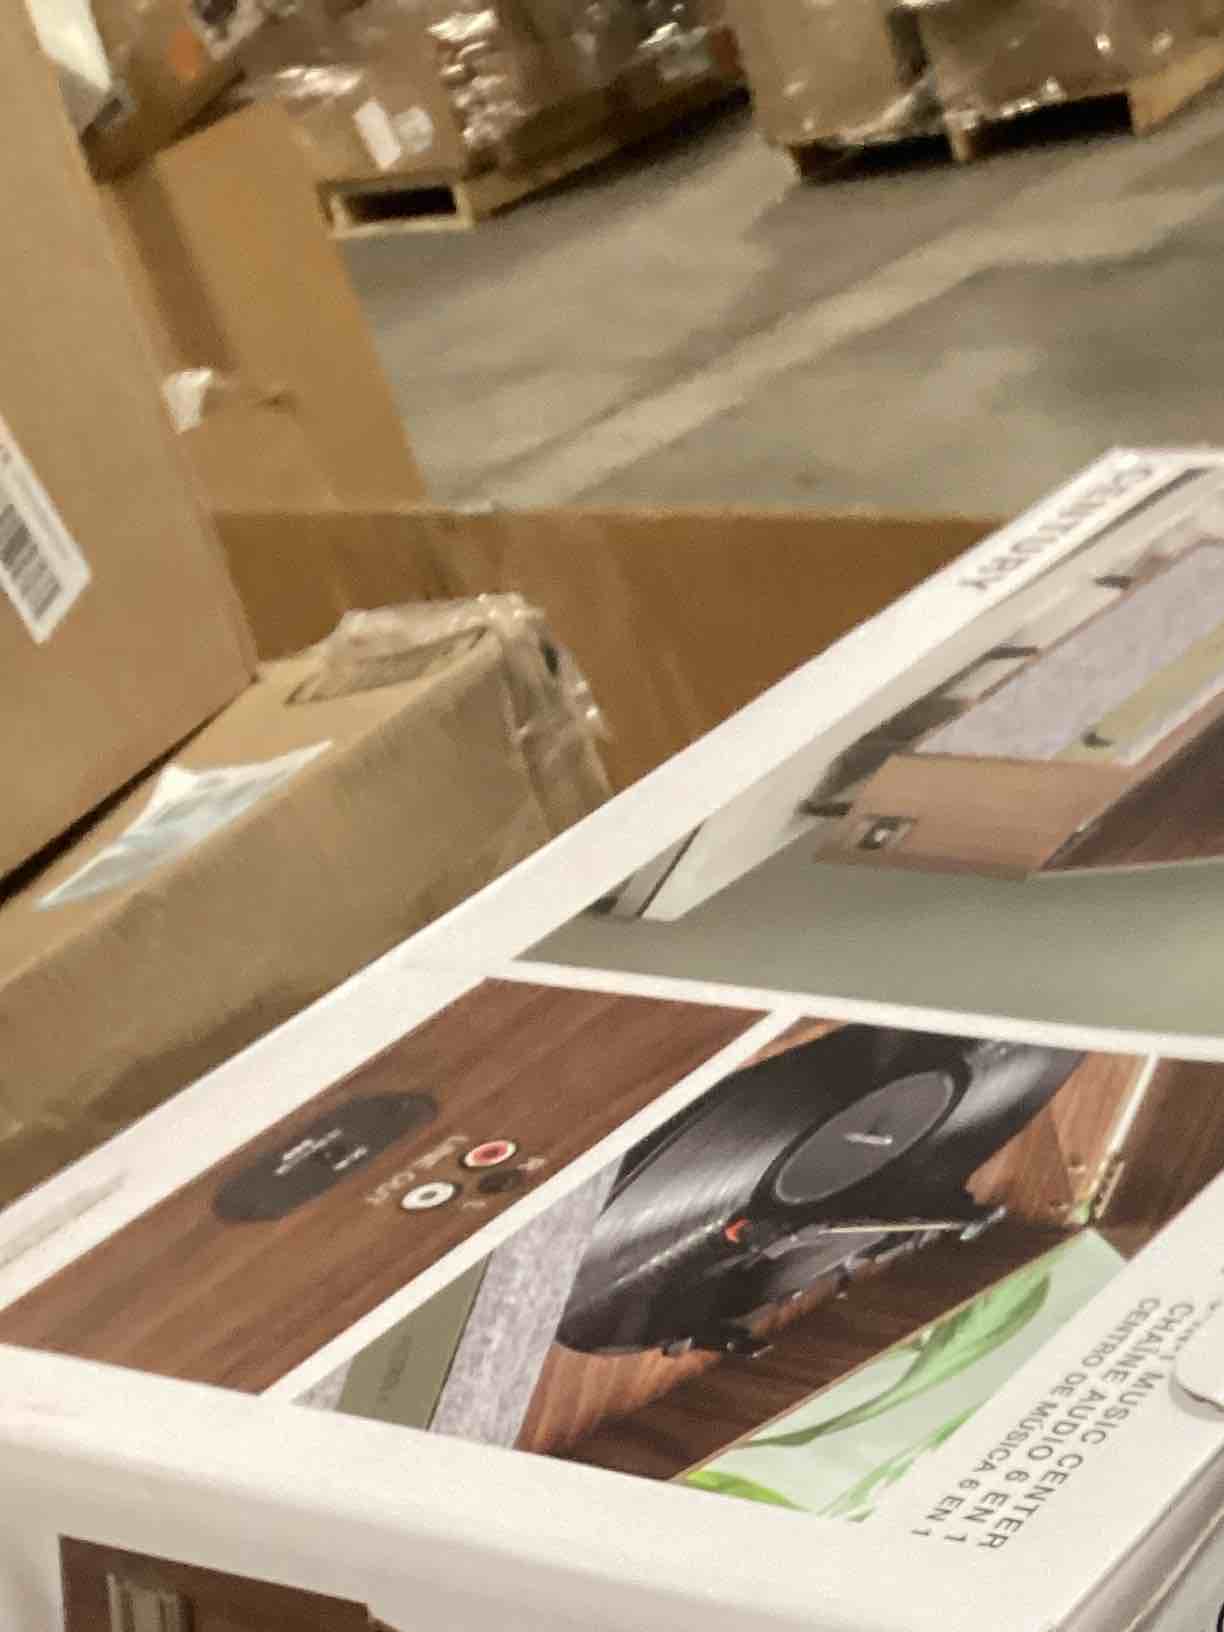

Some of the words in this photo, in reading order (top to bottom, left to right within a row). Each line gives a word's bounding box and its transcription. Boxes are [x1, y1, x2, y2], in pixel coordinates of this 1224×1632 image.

[1081, 1298, 1161, 1367] CENTRO
[1049, 1371, 1088, 1398] DE
[1080, 1371, 1166, 1444] MUSIC
[1027, 1389, 1108, 1461] AUDIO
[957, 1478, 981, 1489] 6
[1004, 1469, 1030, 1483] 6
[925, 1495, 967, 1522] EN
[962, 1491, 1011, 1524] EN
[976, 1453, 1084, 1549] CENTER
